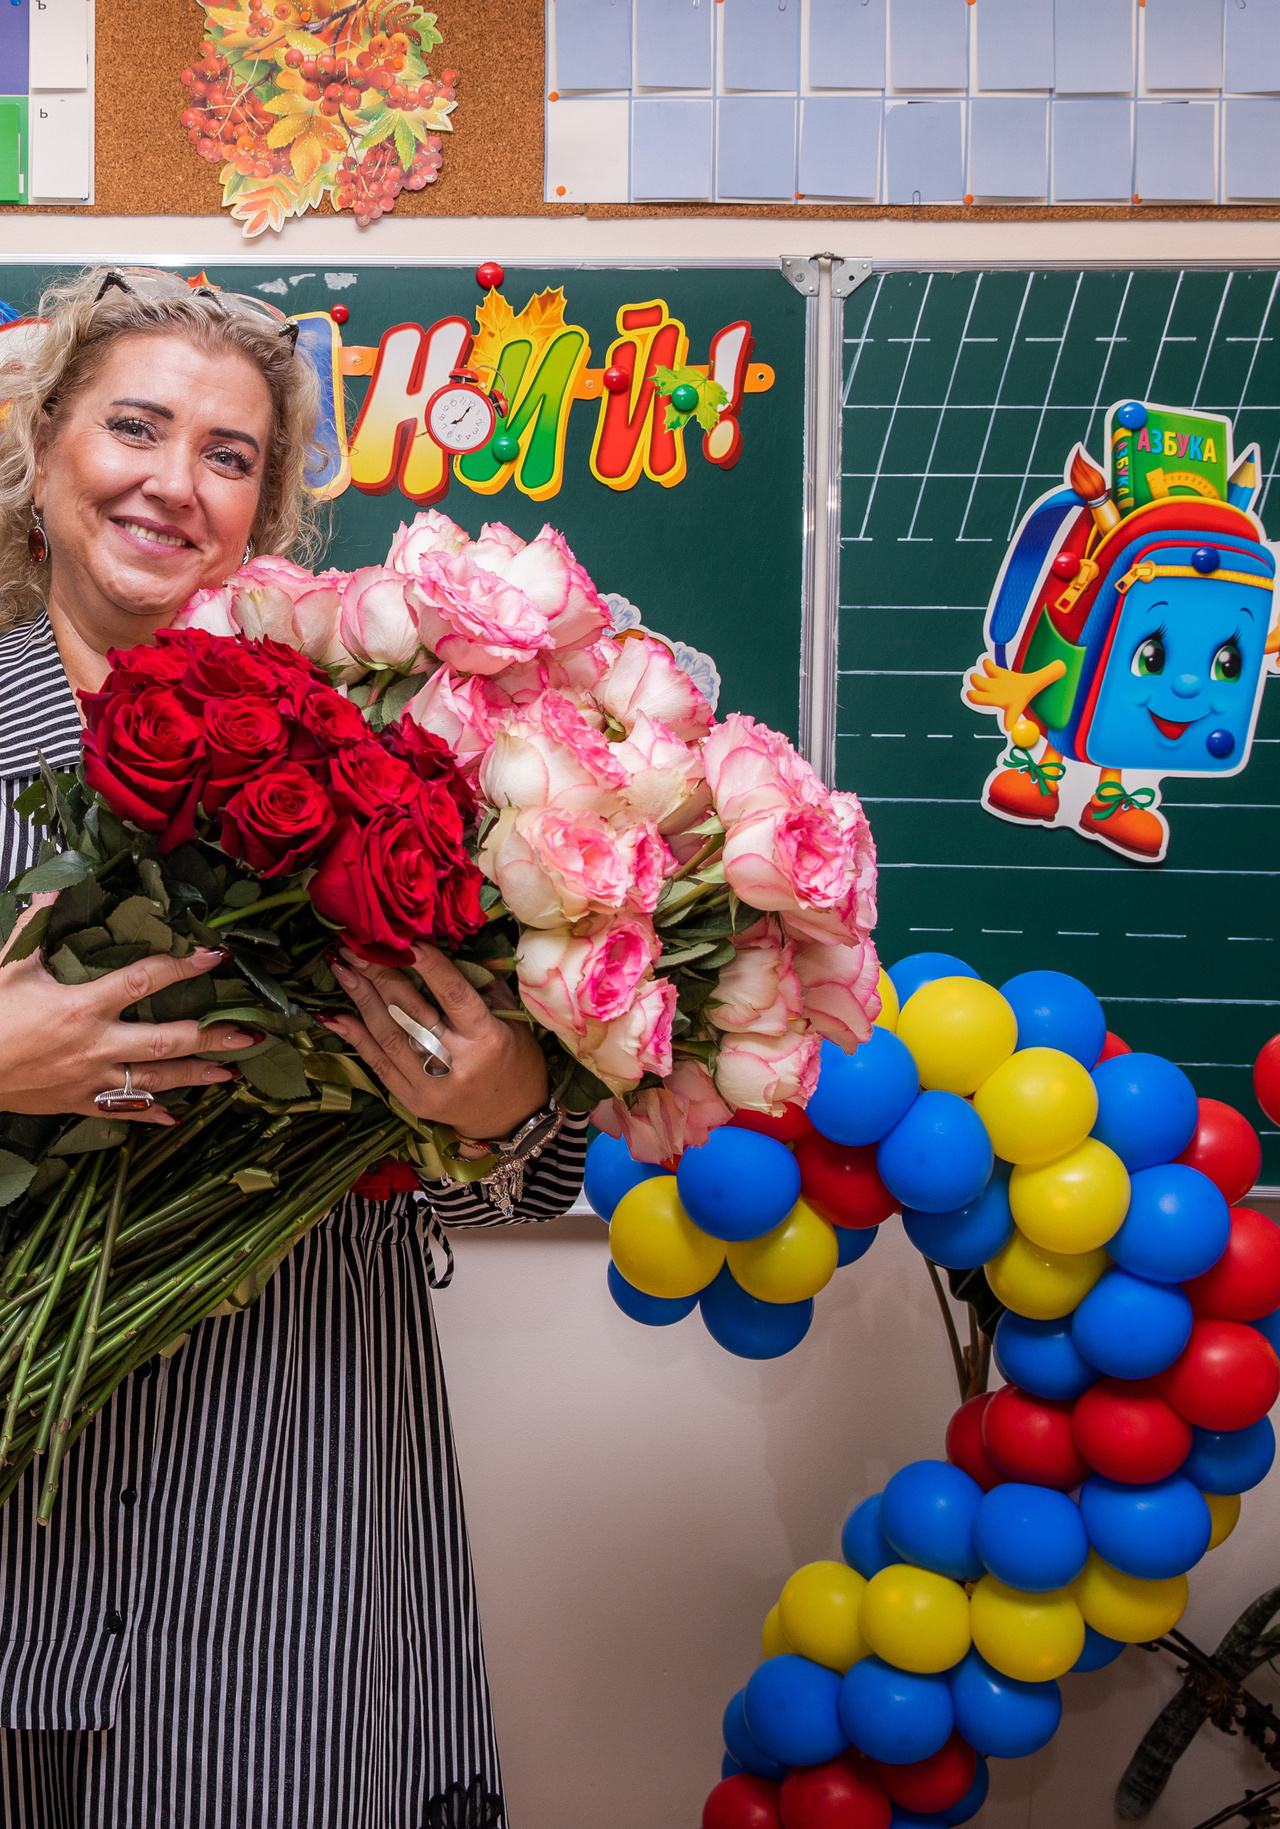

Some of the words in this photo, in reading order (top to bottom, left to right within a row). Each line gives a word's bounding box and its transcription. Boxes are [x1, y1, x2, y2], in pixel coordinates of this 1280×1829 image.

[35, 0, 47, 10] Ъ
[39, 108, 49, 119] Ь
[1136, 427, 1218, 464] АЗБУКА
[1115, 441, 1130, 497] АЗБУКА
